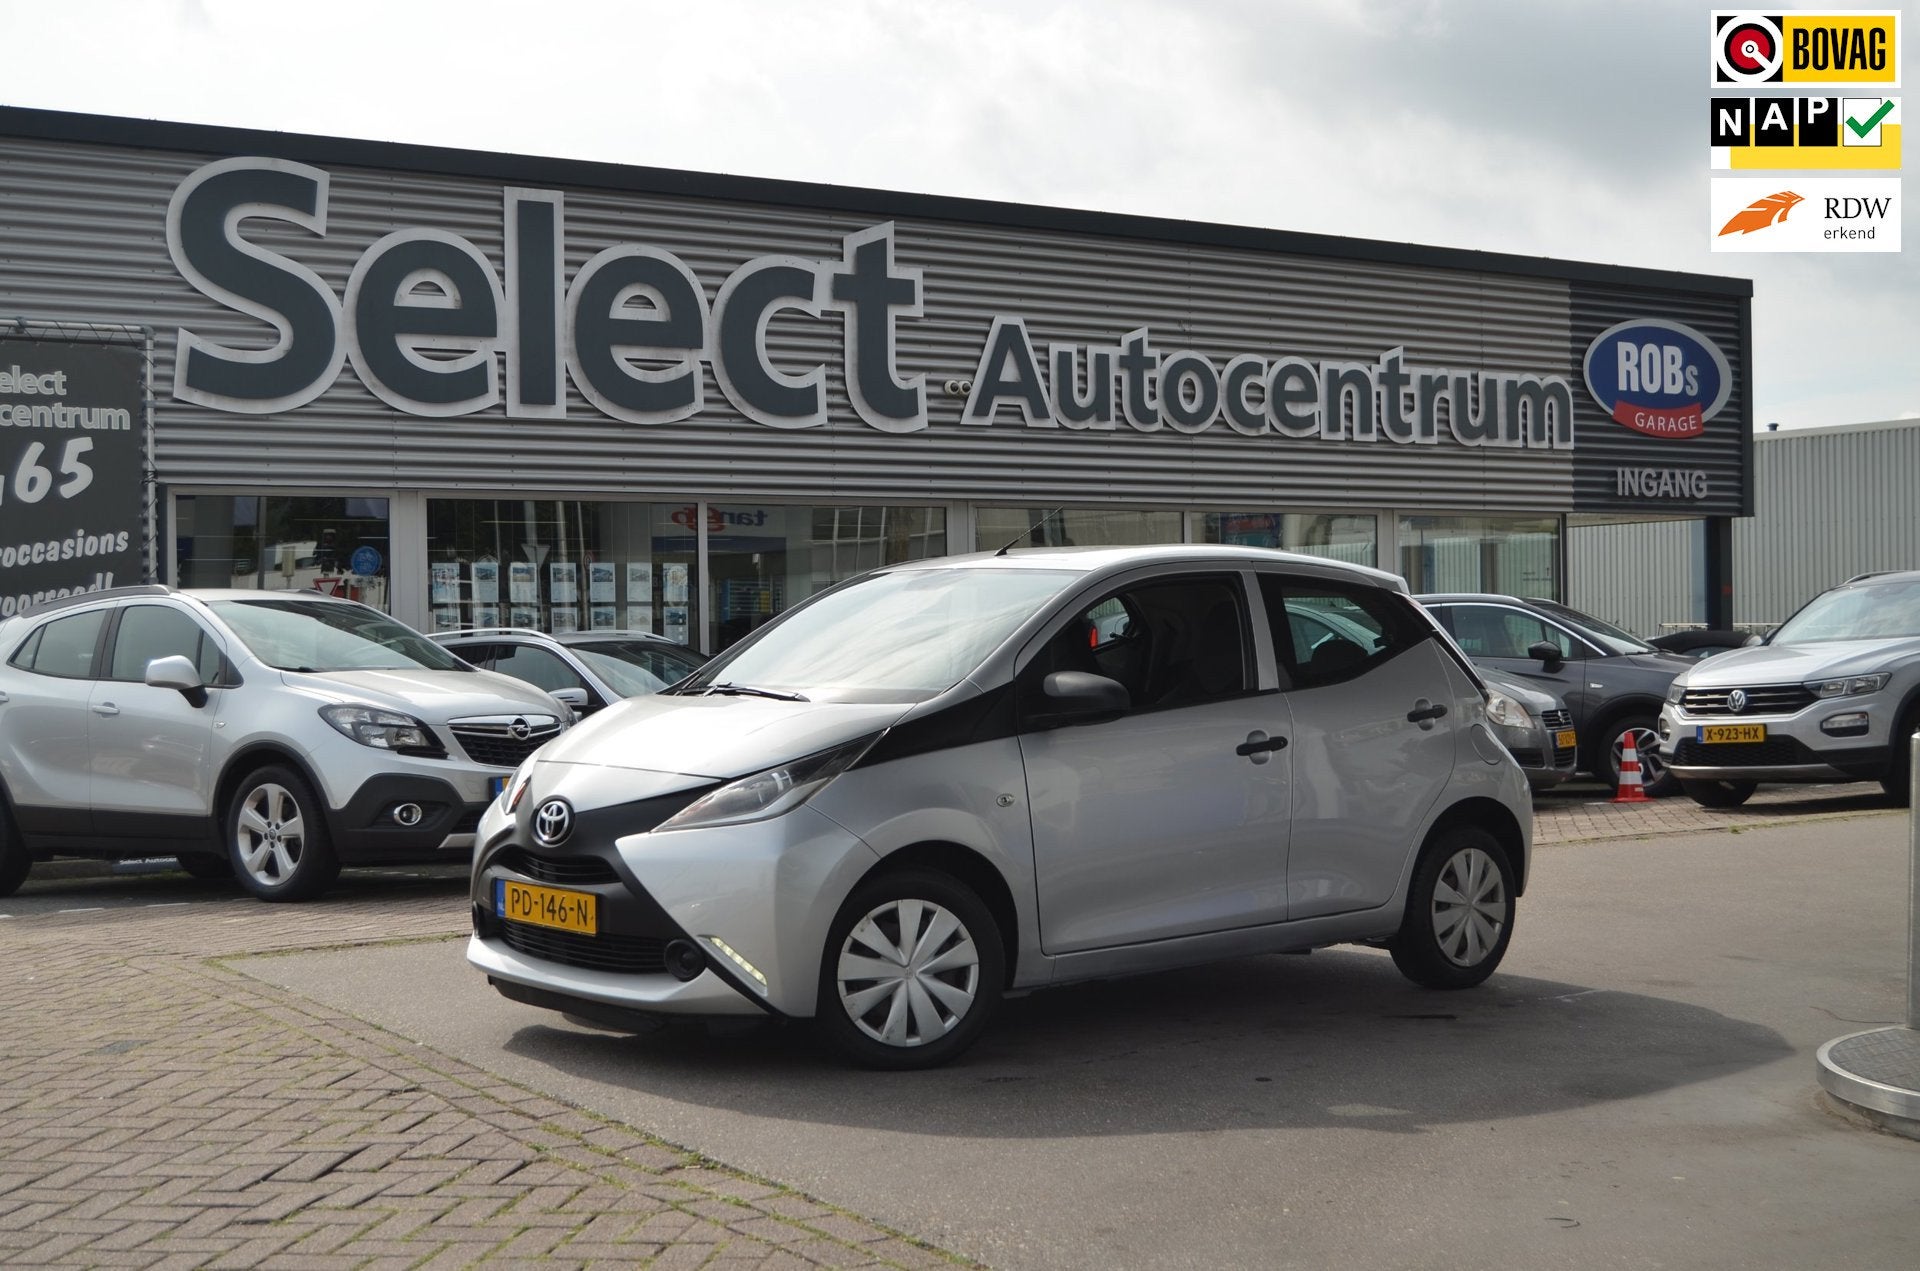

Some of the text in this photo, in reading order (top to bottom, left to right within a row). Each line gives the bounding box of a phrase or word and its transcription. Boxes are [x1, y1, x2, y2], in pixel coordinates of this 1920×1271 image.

[166, 155, 1575, 450] Select Autocentrum
[1617, 341, 1699, 397] ROBs
[1634, 411, 1698, 433] GARAGE
[1617, 466, 1708, 499] INGANG
[1706, 727, 1759, 741] X-923-HX
[511, 888, 588, 926] PD-146-N
